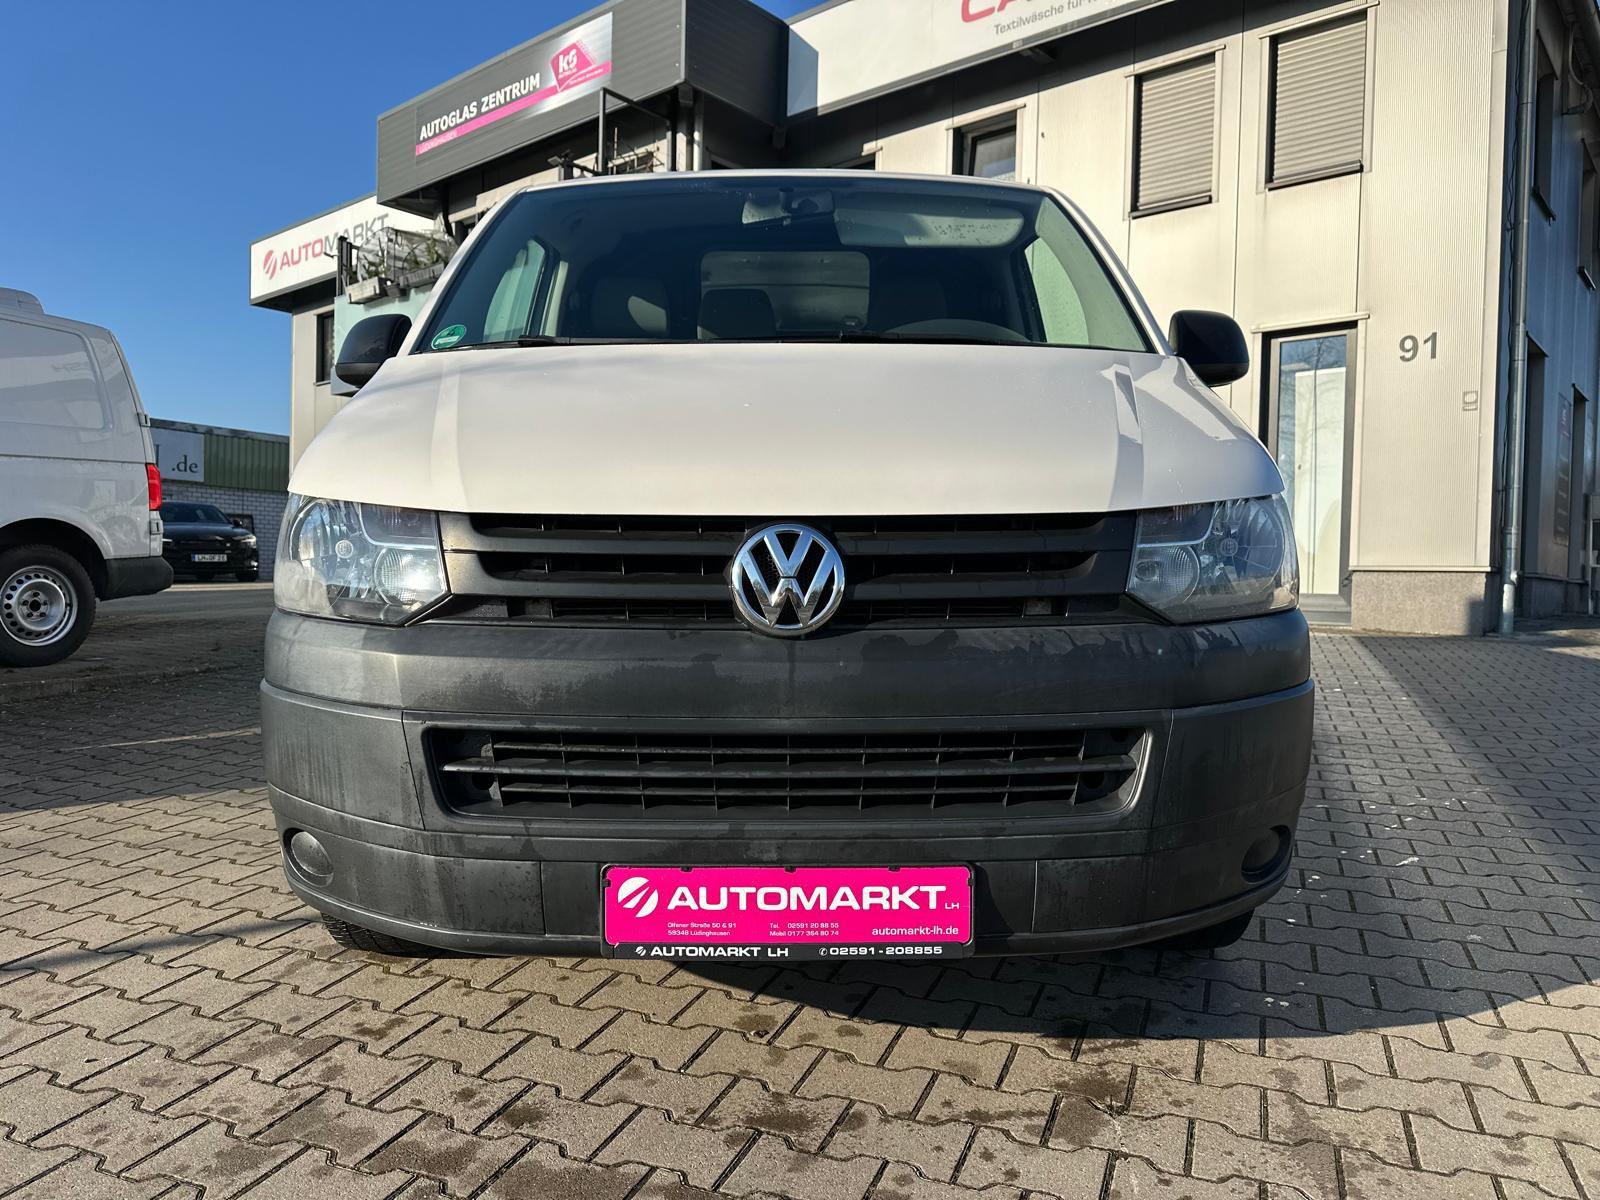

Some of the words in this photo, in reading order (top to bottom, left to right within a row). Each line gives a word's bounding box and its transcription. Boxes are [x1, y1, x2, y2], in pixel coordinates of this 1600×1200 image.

[993, 4, 1064, 35] Textilwäsche
[419, 101, 478, 141] AUTOGLAS
[481, 72, 541, 113] ZENTRUM
[1399, 332, 1438, 362] 91
[667, 885, 947, 911] AUTOMARKT
[944, 902, 960, 910] LH
[871, 925, 959, 936] automarkt-lh.de
[650, 946, 762, 957] AUTOMARKT
[767, 947, 789, 957] LH
